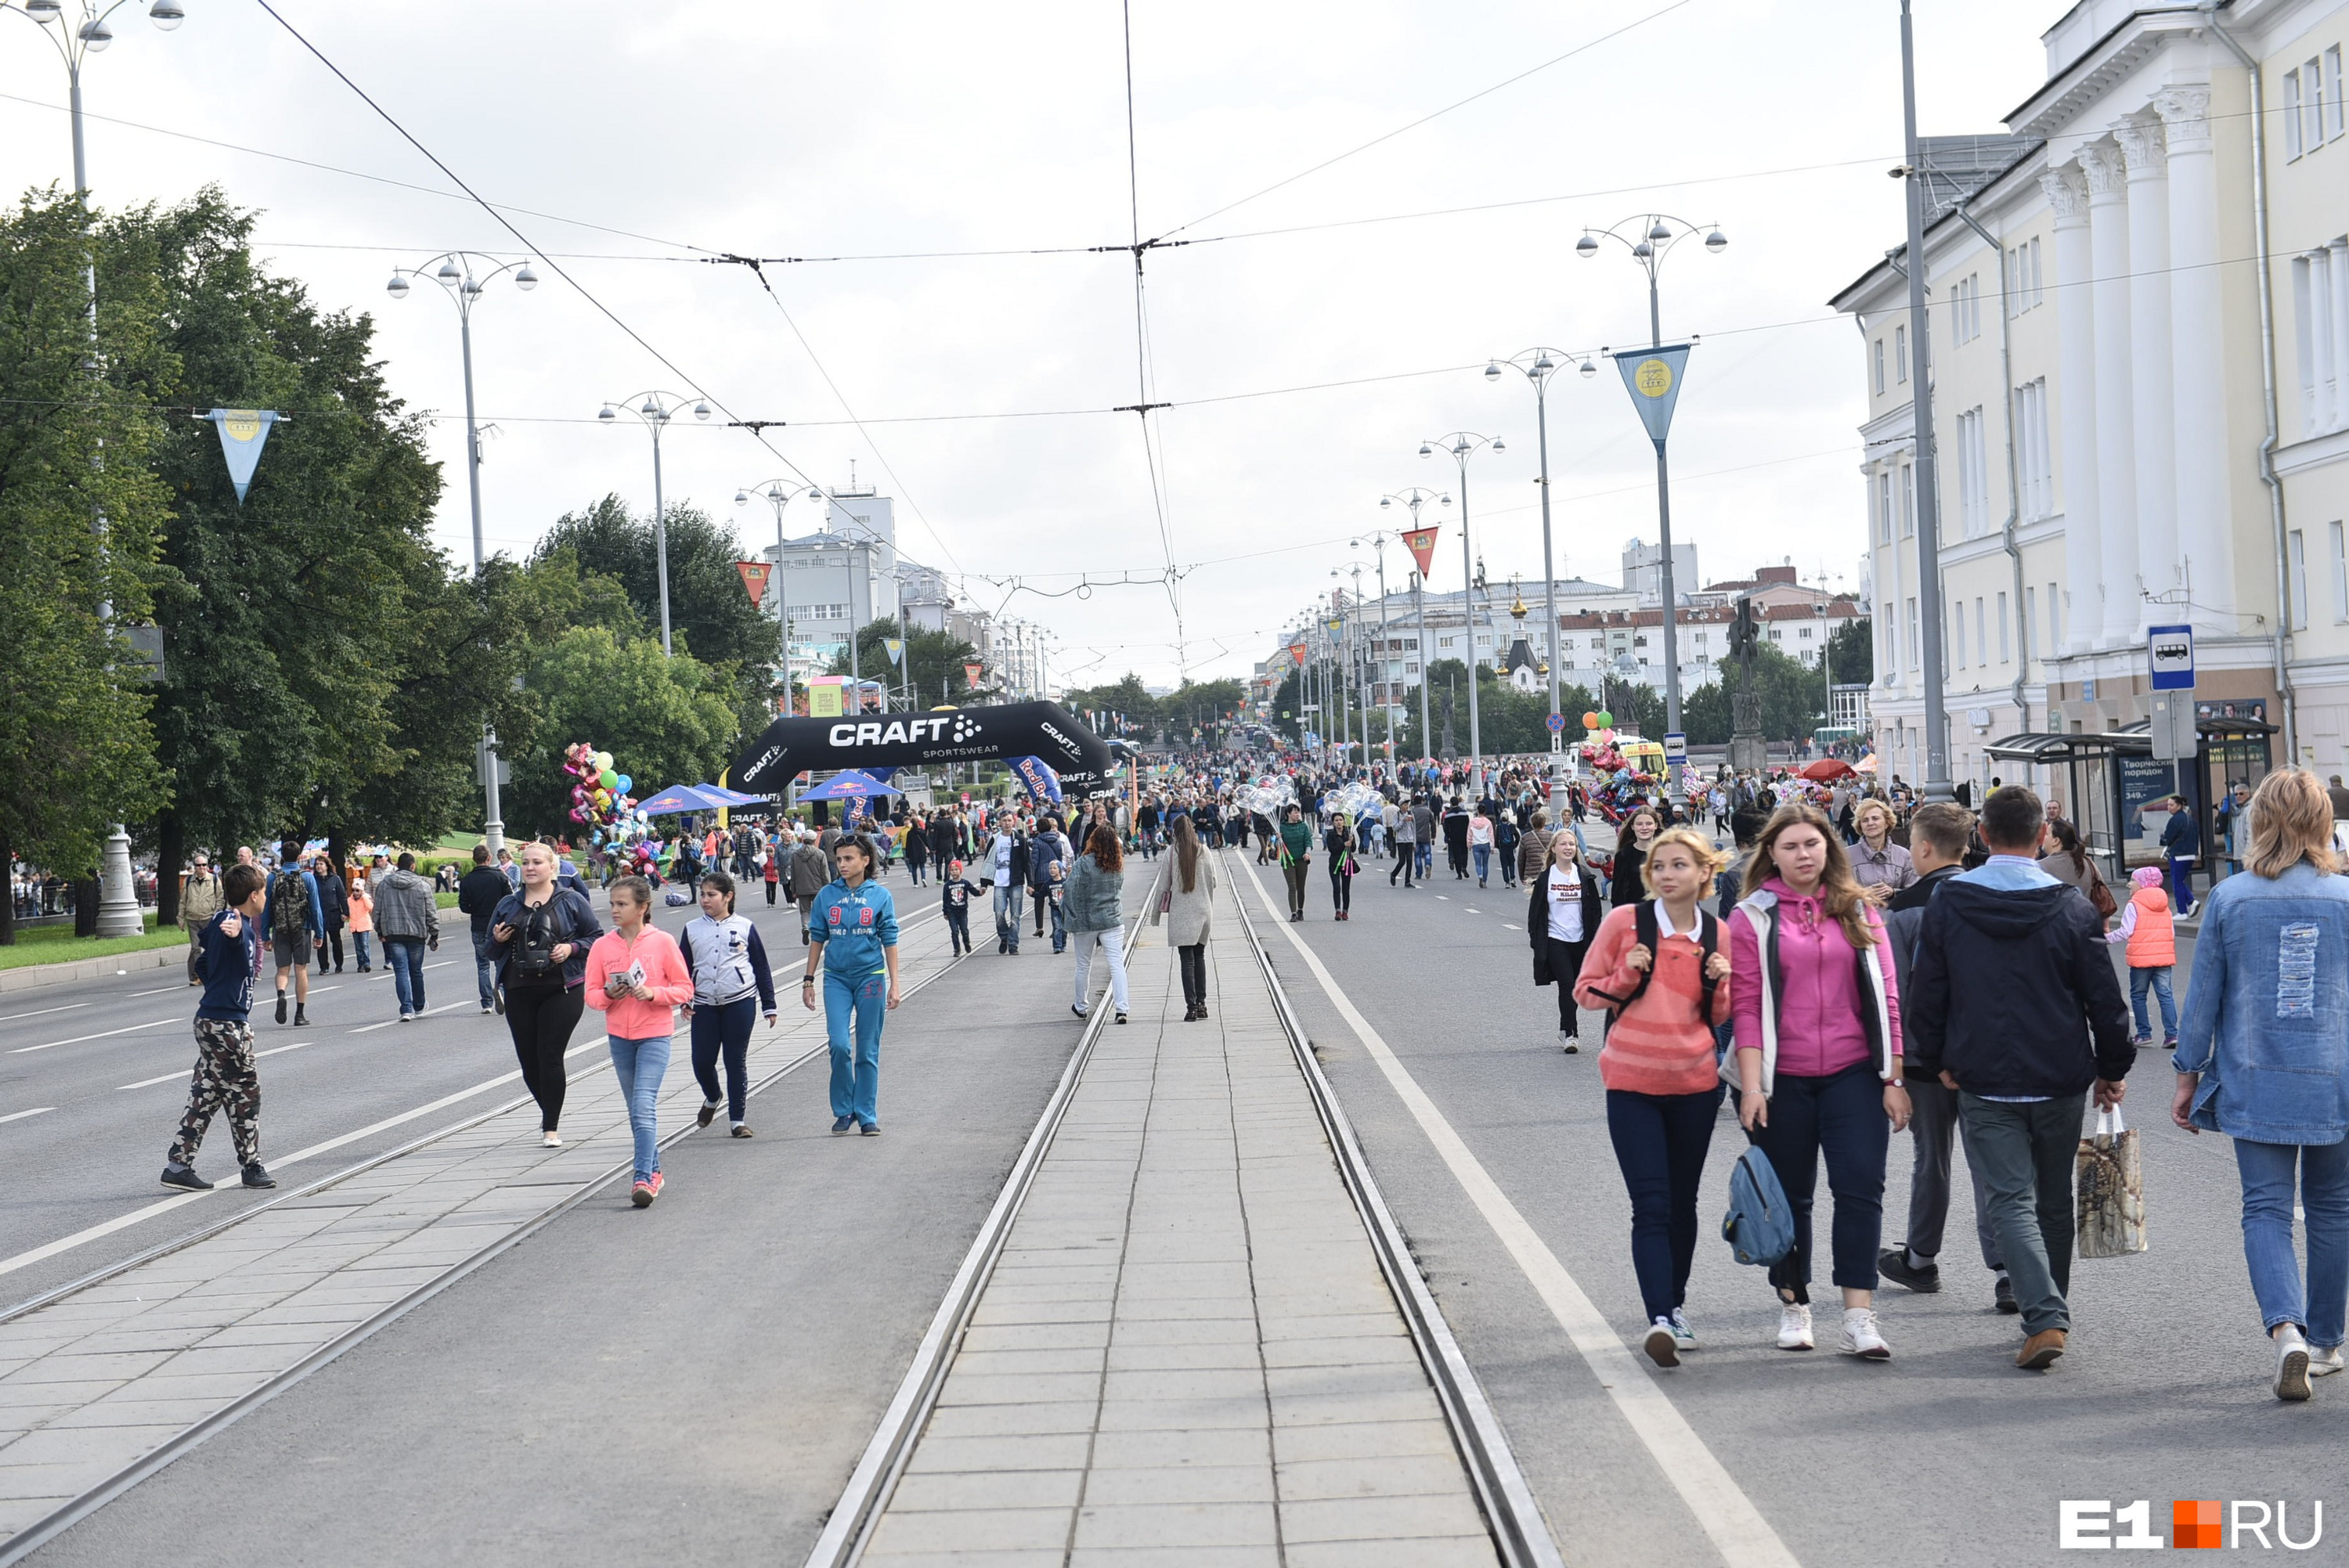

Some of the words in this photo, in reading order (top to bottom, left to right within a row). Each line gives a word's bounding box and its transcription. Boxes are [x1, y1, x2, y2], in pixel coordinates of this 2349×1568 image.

[828, 718, 950, 747] CRAFT
[1041, 722, 1076, 748] CRAFT
[923, 745, 998, 758] SPORTSWEAR
[743, 750, 772, 782] CRAFT
[2123, 759, 2174, 769] Творчески
[1019, 758, 1042, 784] Red
[1032, 781, 1052, 802] Bu
[1060, 773, 1086, 782] CRAFT
[2124, 769, 2163, 777] порядок
[1089, 789, 1115, 799] CRAF
[849, 795, 866, 821] Red
[731, 814, 762, 823] CRAFT
[828, 906, 842, 926] 9
[859, 907, 873, 926] 8
